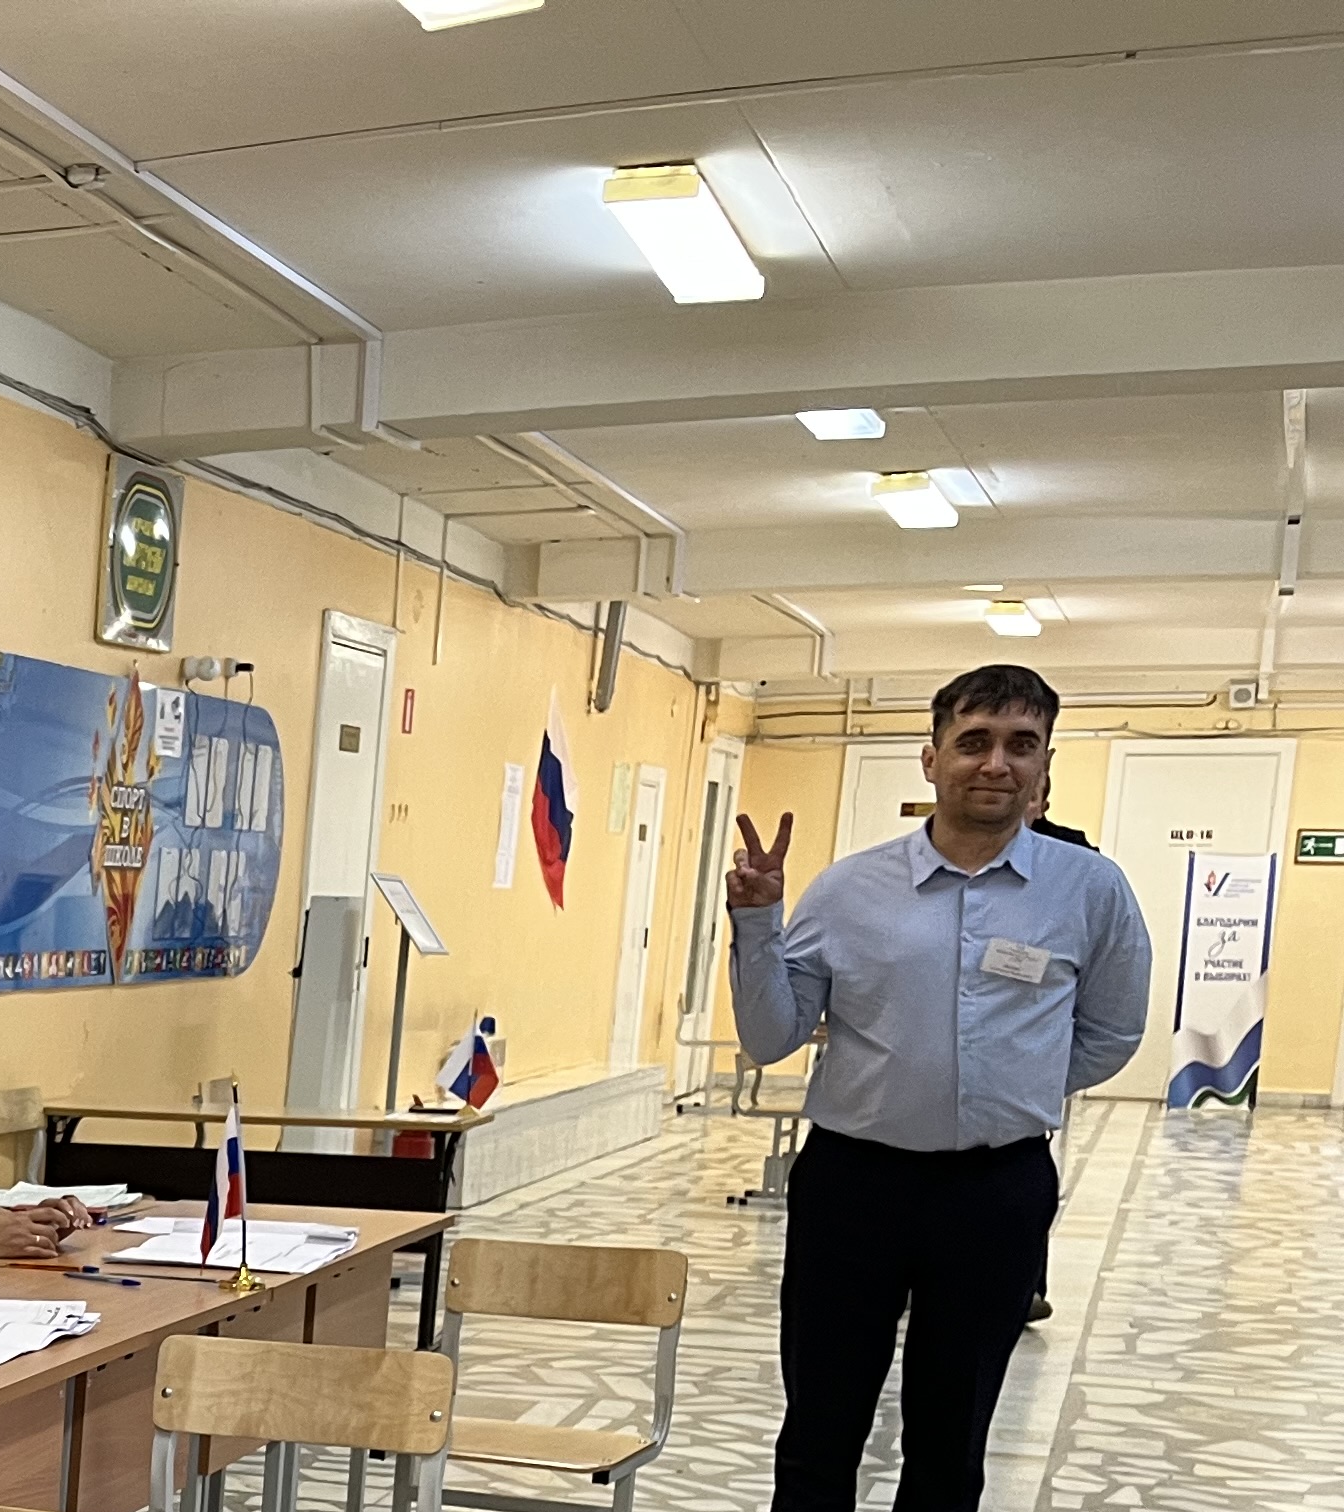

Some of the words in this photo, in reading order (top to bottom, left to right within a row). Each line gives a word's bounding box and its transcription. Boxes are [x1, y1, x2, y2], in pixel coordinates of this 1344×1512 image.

[111, 786, 145, 810] СПОРТ
[121, 816, 130, 838] В
[103, 845, 143, 867] ШКОЛЕ
[1196, 917, 1258, 928] БЛАГОДАРИМ
[1203, 959, 1243, 969] УЧАСТИЕ
